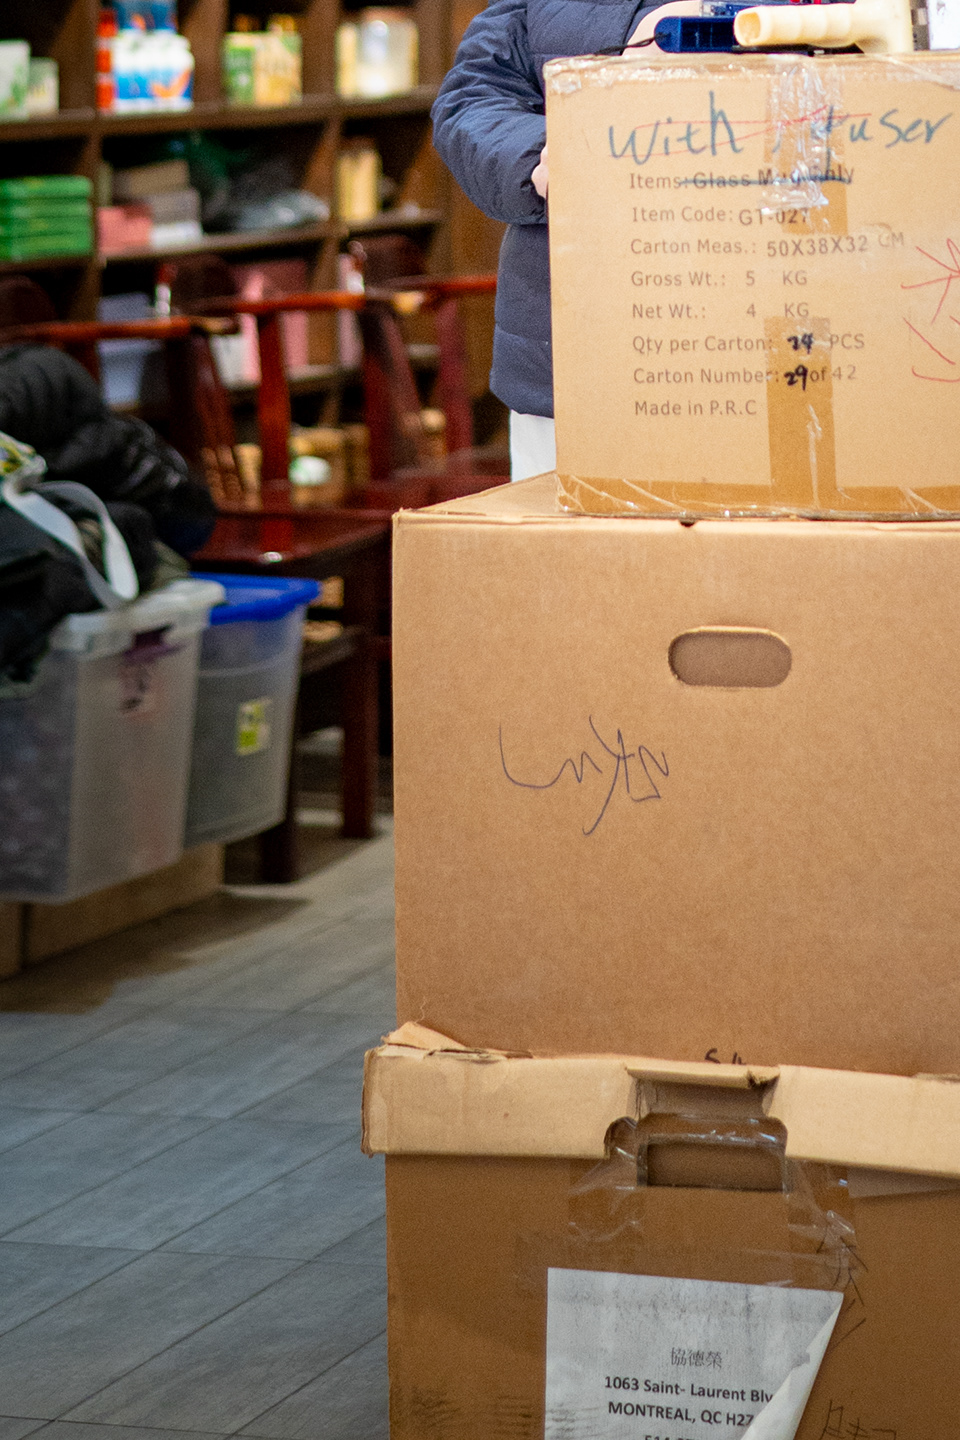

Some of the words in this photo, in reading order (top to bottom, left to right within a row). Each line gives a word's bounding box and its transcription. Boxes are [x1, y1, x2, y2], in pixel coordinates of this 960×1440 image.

[608, 90, 743, 165] With
[693, 171, 751, 188] Glass
[632, 207, 678, 223] Item
[682, 206, 735, 223] Code:
[630, 238, 691, 255] Carton
[697, 238, 757, 255] Meas.:
[766, 234, 869, 258] 50X38X32
[631, 271, 683, 287] Gross
[688, 270, 726, 287] Wt.:
[745, 270, 756, 287] 5
[782, 270, 808, 286] KG
[631, 303, 663, 319] Net
[668, 303, 706, 319] Wt.:
[746, 303, 757, 318] 4
[784, 302, 810, 319] KG
[632, 336, 664, 356] Qty
[669, 338, 699, 355] per
[704, 335, 773, 352] Carton:
[829, 333, 866, 350] PCS
[633, 368, 694, 384] Carton
[700, 367, 780, 383] Number:
[783, 364, 808, 392] 29
[809, 366, 829, 383] of
[634, 400, 682, 416] Made
[687, 400, 704, 415] in
[710, 399, 757, 416] P.R.C
[604, 1375, 640, 1392] 1063
[643, 1378, 686, 1396] Saint-
[690, 1383, 746, 1402] Laurent
[750, 1389, 774, 1404] Blv
[607, 1400, 696, 1425] MONTREAL,
[700, 1409, 723, 1425] QC
